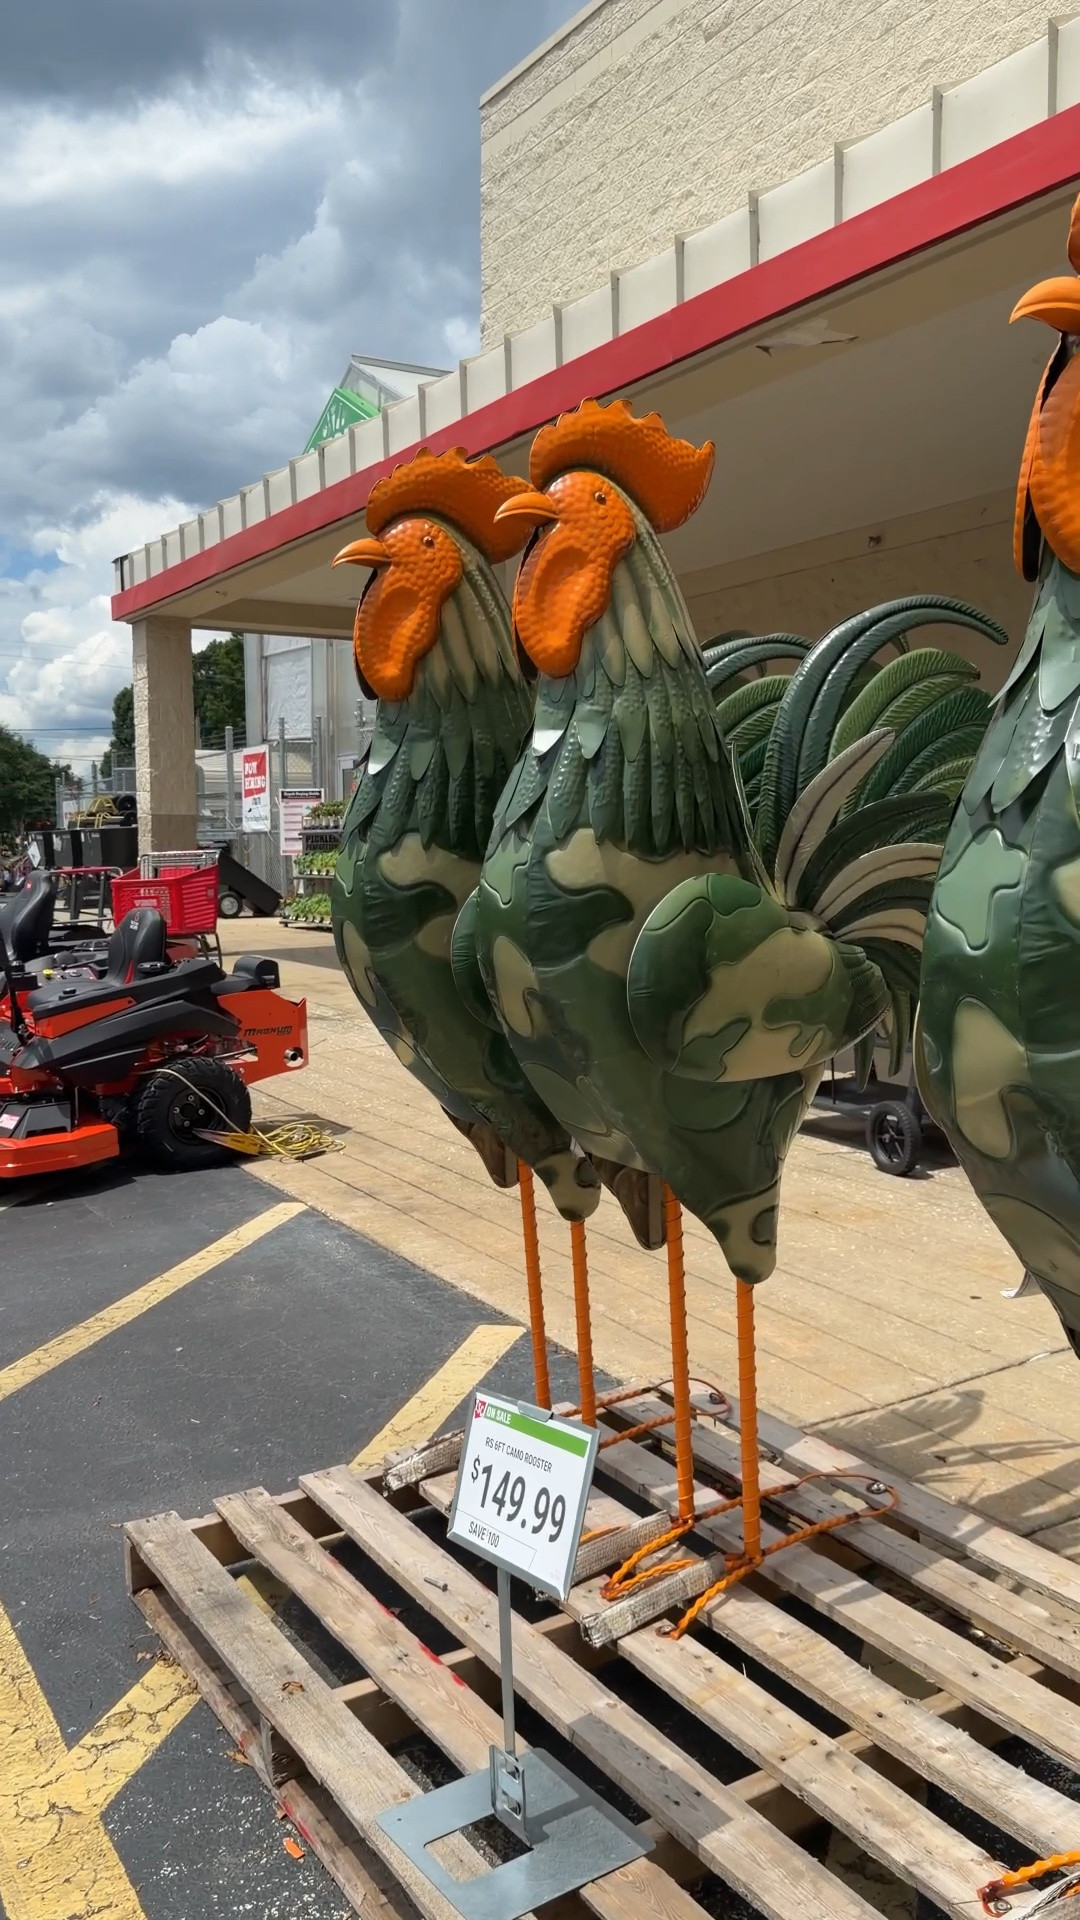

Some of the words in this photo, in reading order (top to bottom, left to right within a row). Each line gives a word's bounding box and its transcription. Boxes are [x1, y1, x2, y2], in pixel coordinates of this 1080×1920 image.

[486, 1406, 496, 1419] ON
[496, 1410, 511, 1425] SALE
[485, 1436, 494, 1449] RS
[494, 1440, 506, 1453] 6FT
[506, 1445, 524, 1461] CAMO
[524, 1453, 553, 1474] ROOSTER
[471, 1454, 566, 1543] $149.99
[468, 1521, 487, 1541] SAVE
